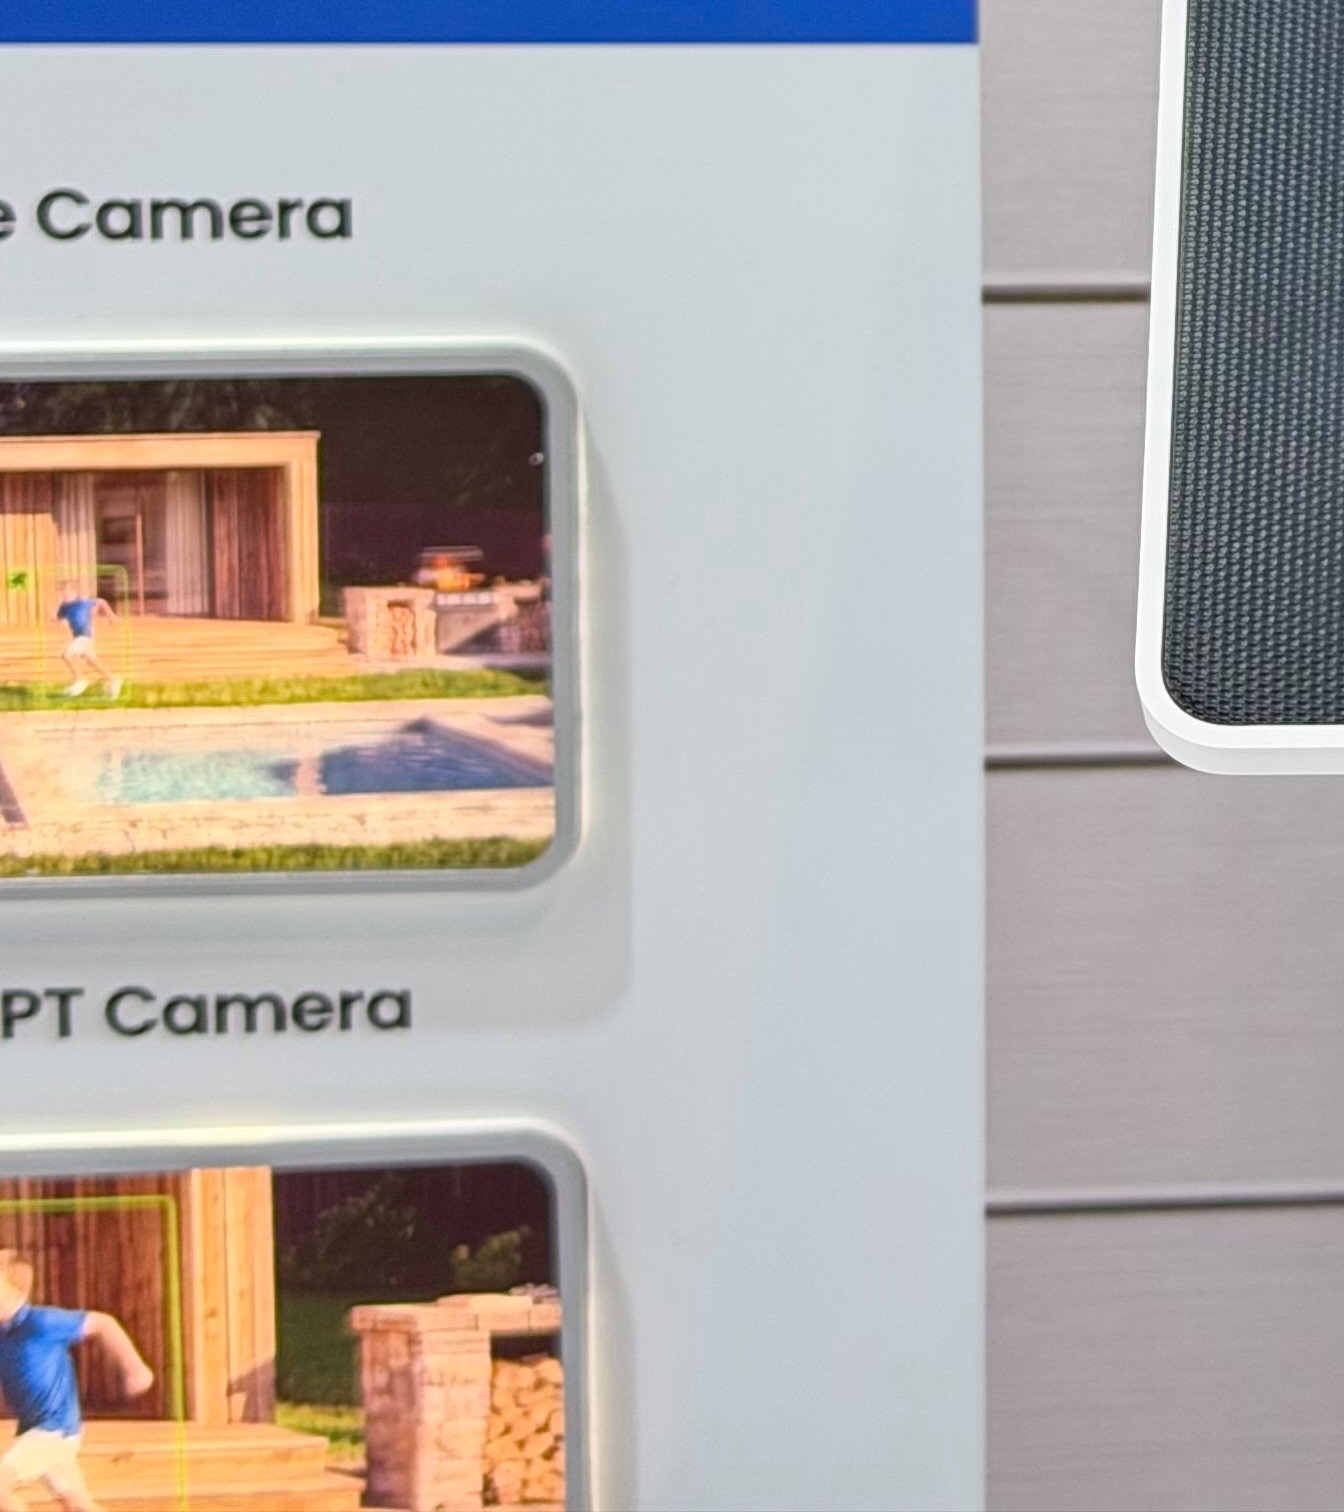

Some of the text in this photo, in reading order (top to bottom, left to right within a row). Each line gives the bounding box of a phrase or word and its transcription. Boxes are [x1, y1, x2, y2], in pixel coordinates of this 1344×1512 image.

[36, 188, 354, 242] Camera
[2, 985, 413, 1039] PT Camera
